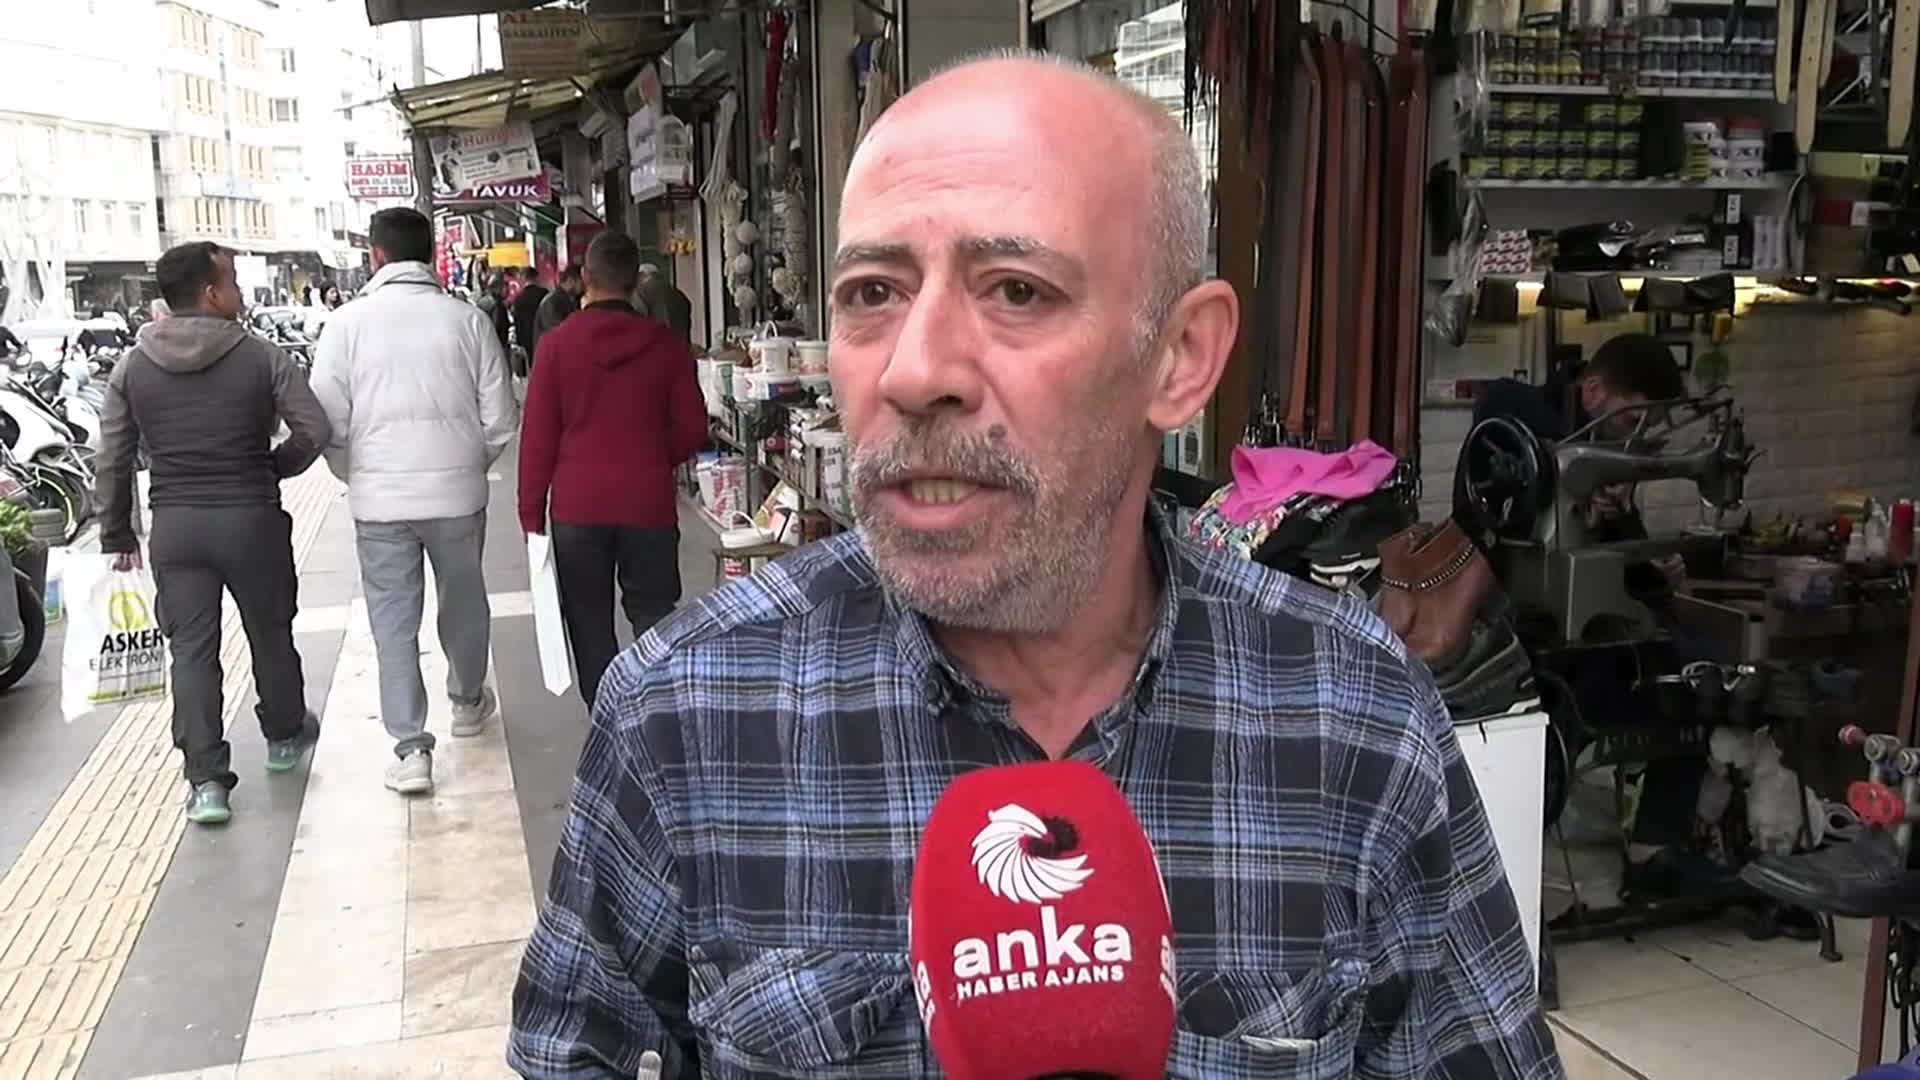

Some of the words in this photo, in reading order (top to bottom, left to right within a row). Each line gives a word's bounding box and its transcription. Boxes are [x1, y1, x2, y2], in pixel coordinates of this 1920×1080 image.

[470, 183, 538, 198] TAVUK
[100, 628, 164, 656] ASKER
[952, 905, 1132, 978] anka
[956, 970, 1039, 1000] HABER
[1044, 964, 1126, 988] AJANS
